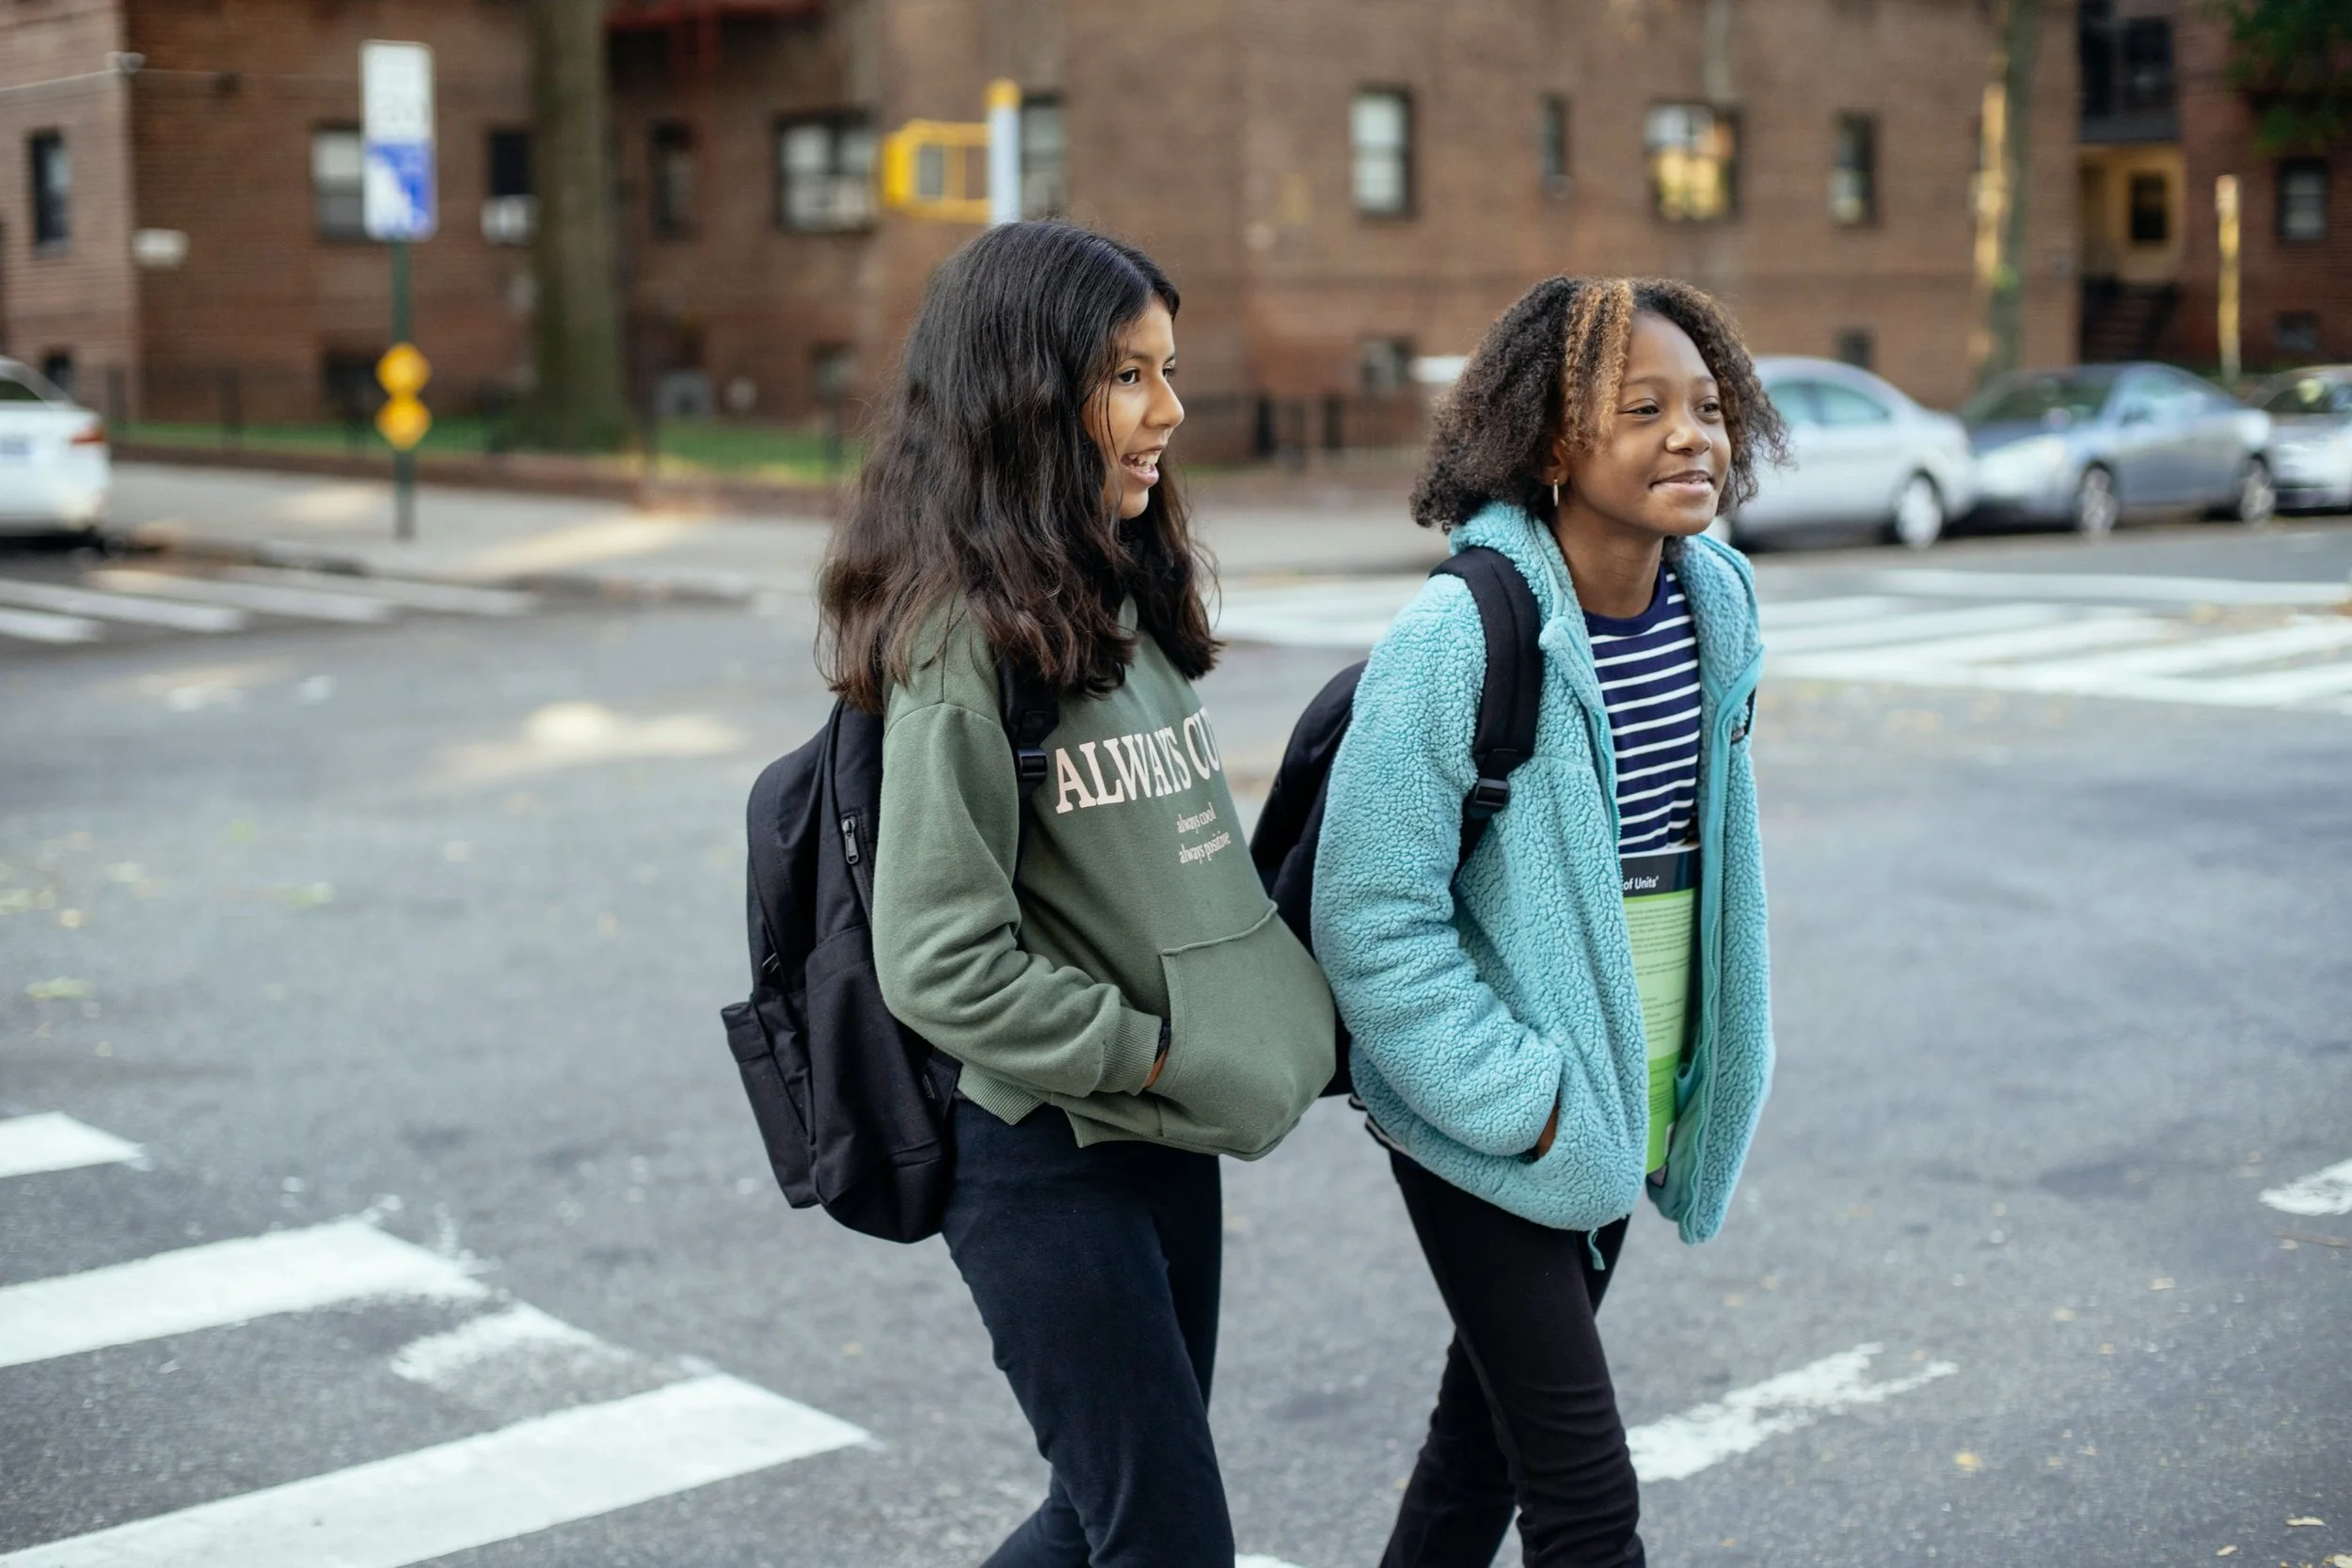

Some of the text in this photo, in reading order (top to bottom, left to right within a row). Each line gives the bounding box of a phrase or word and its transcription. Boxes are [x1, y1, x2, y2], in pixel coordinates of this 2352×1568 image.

[1055, 726, 1192, 815] ALWAYS
[1176, 801, 1217, 834] always cool
[1178, 831, 1232, 864] always positive
[1623, 877, 1634, 891] of
